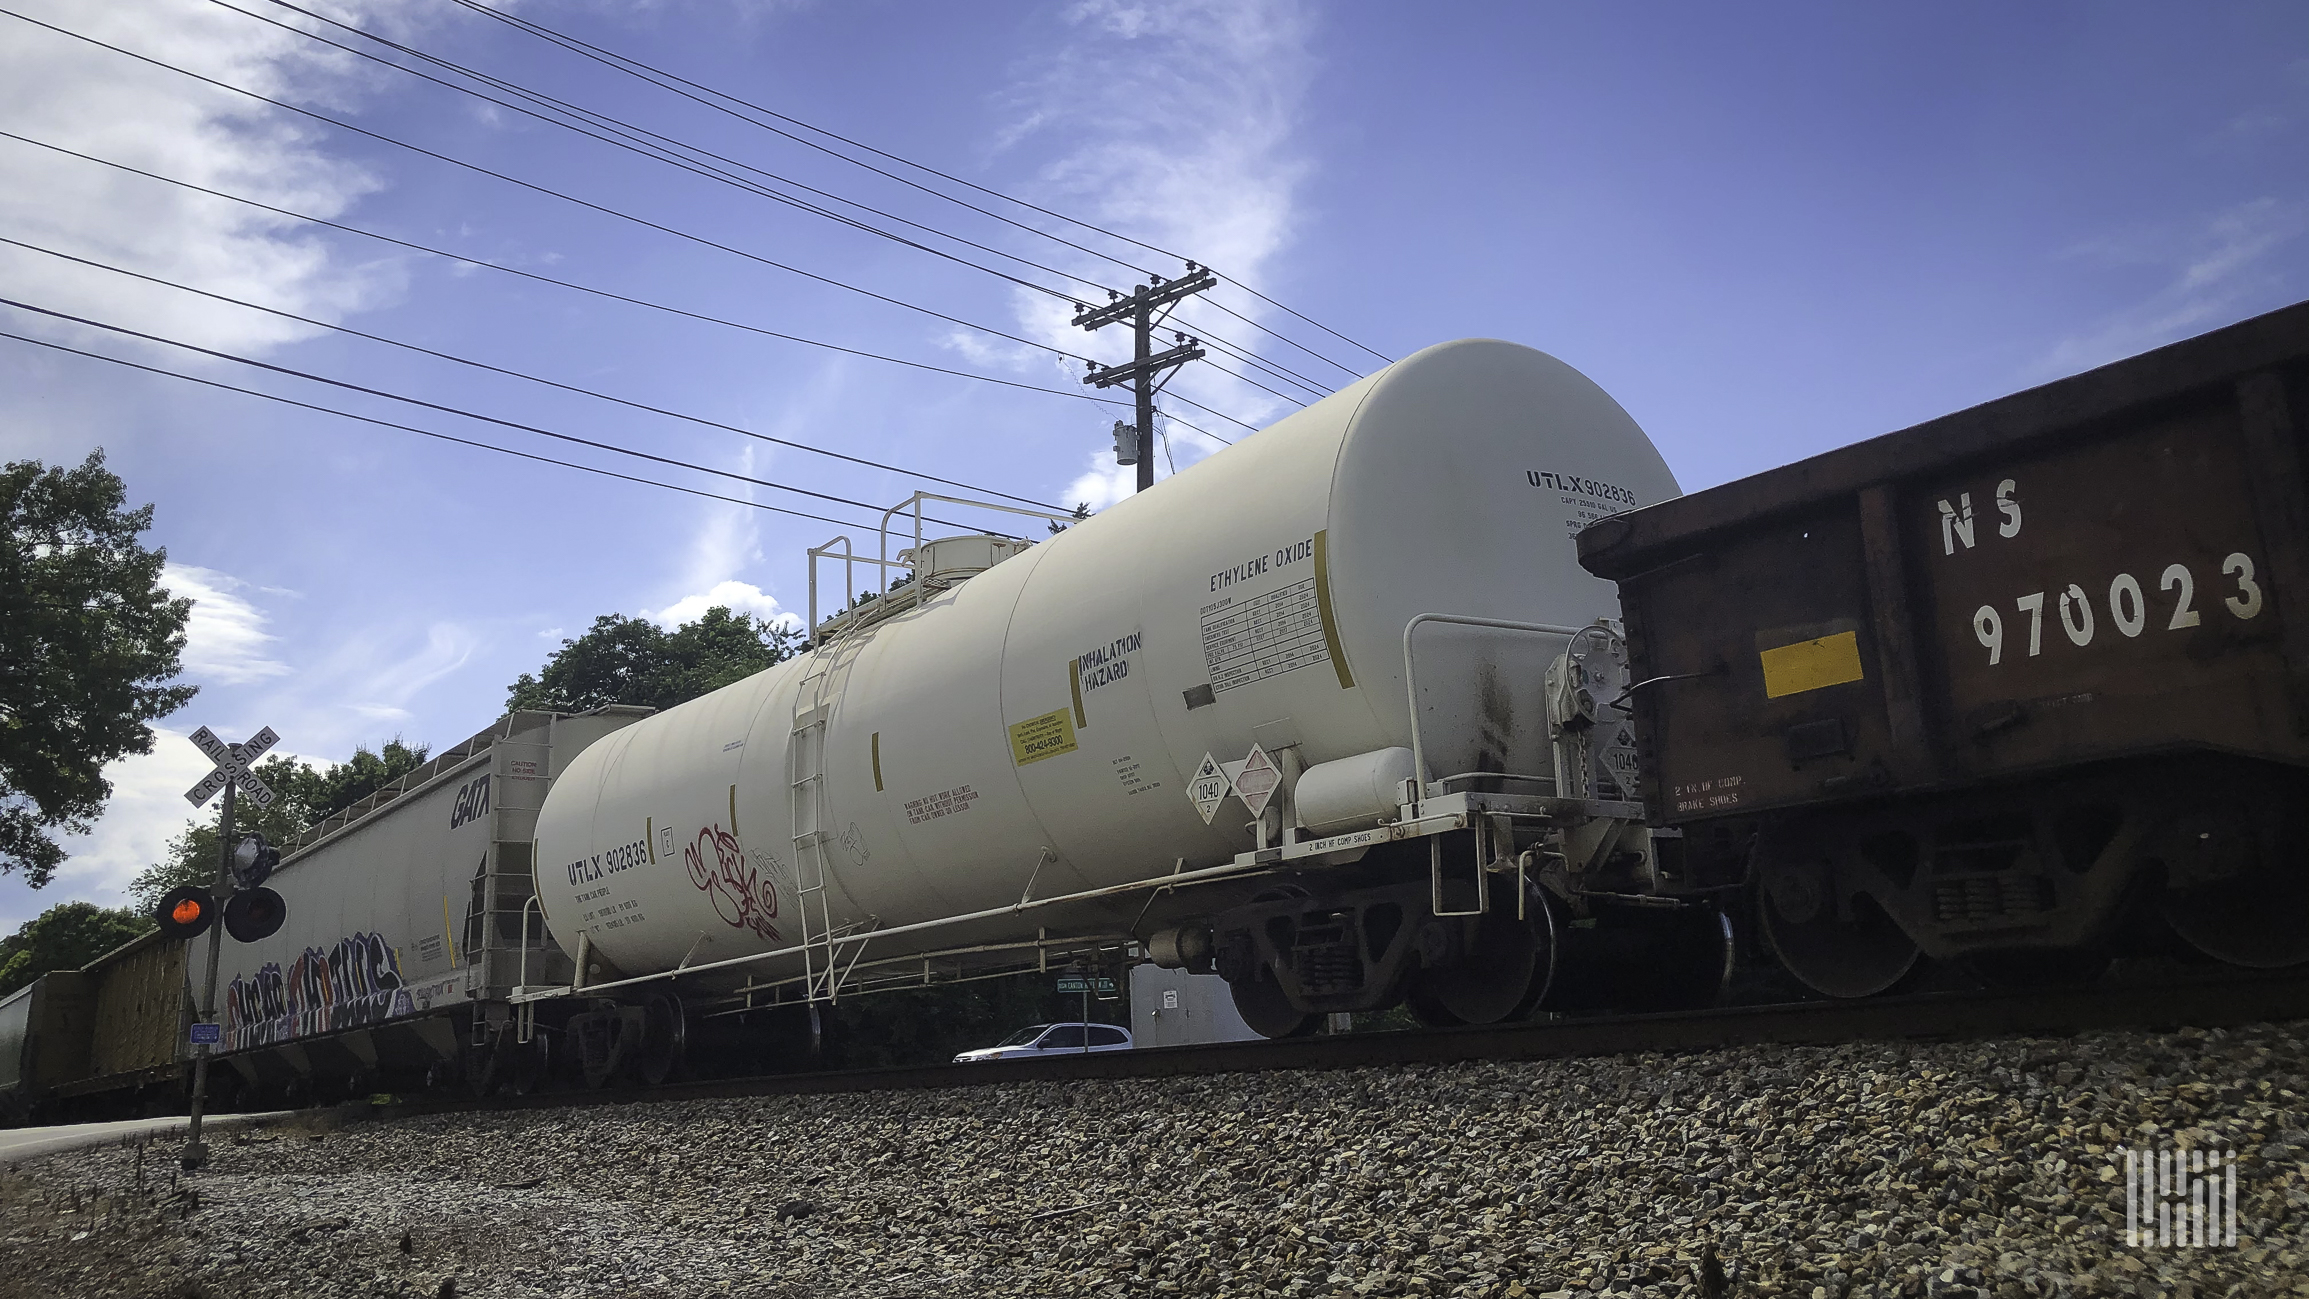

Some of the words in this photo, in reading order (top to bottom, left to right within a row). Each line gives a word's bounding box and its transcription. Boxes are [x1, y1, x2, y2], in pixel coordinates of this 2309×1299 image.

[1527, 470, 1584, 493] UTLX
[1585, 480, 1636, 506] 902836
[1210, 555, 1268, 592] ETHYLENE
[1276, 538, 1313, 568] OXIDE
[1973, 552, 2262, 666] 970023
[1078, 632, 1141, 676] INHALATION
[1084, 660, 1128, 694] HAZARD
[1024, 735, 1063, 754] 800-424-9300
[193, 732, 272, 800] CROSSING
[194, 730, 225, 762] RAIL
[237, 771, 271, 804] ROAD
[1198, 782, 1219, 800] 1040
[1674, 786, 1680, 796] 2
[1677, 799, 1704, 812] BRAKE
[1709, 793, 1738, 806] SHOES
[1206, 805, 1210, 813] 2
[1310, 843, 1313, 851] 2
[1314, 840, 1326, 850] INCH
[1337, 837, 1352, 846] COMP
[1354, 832, 1371, 844] SHOES
[568, 854, 604, 886] UTLX
[606, 840, 647, 874] 902836
